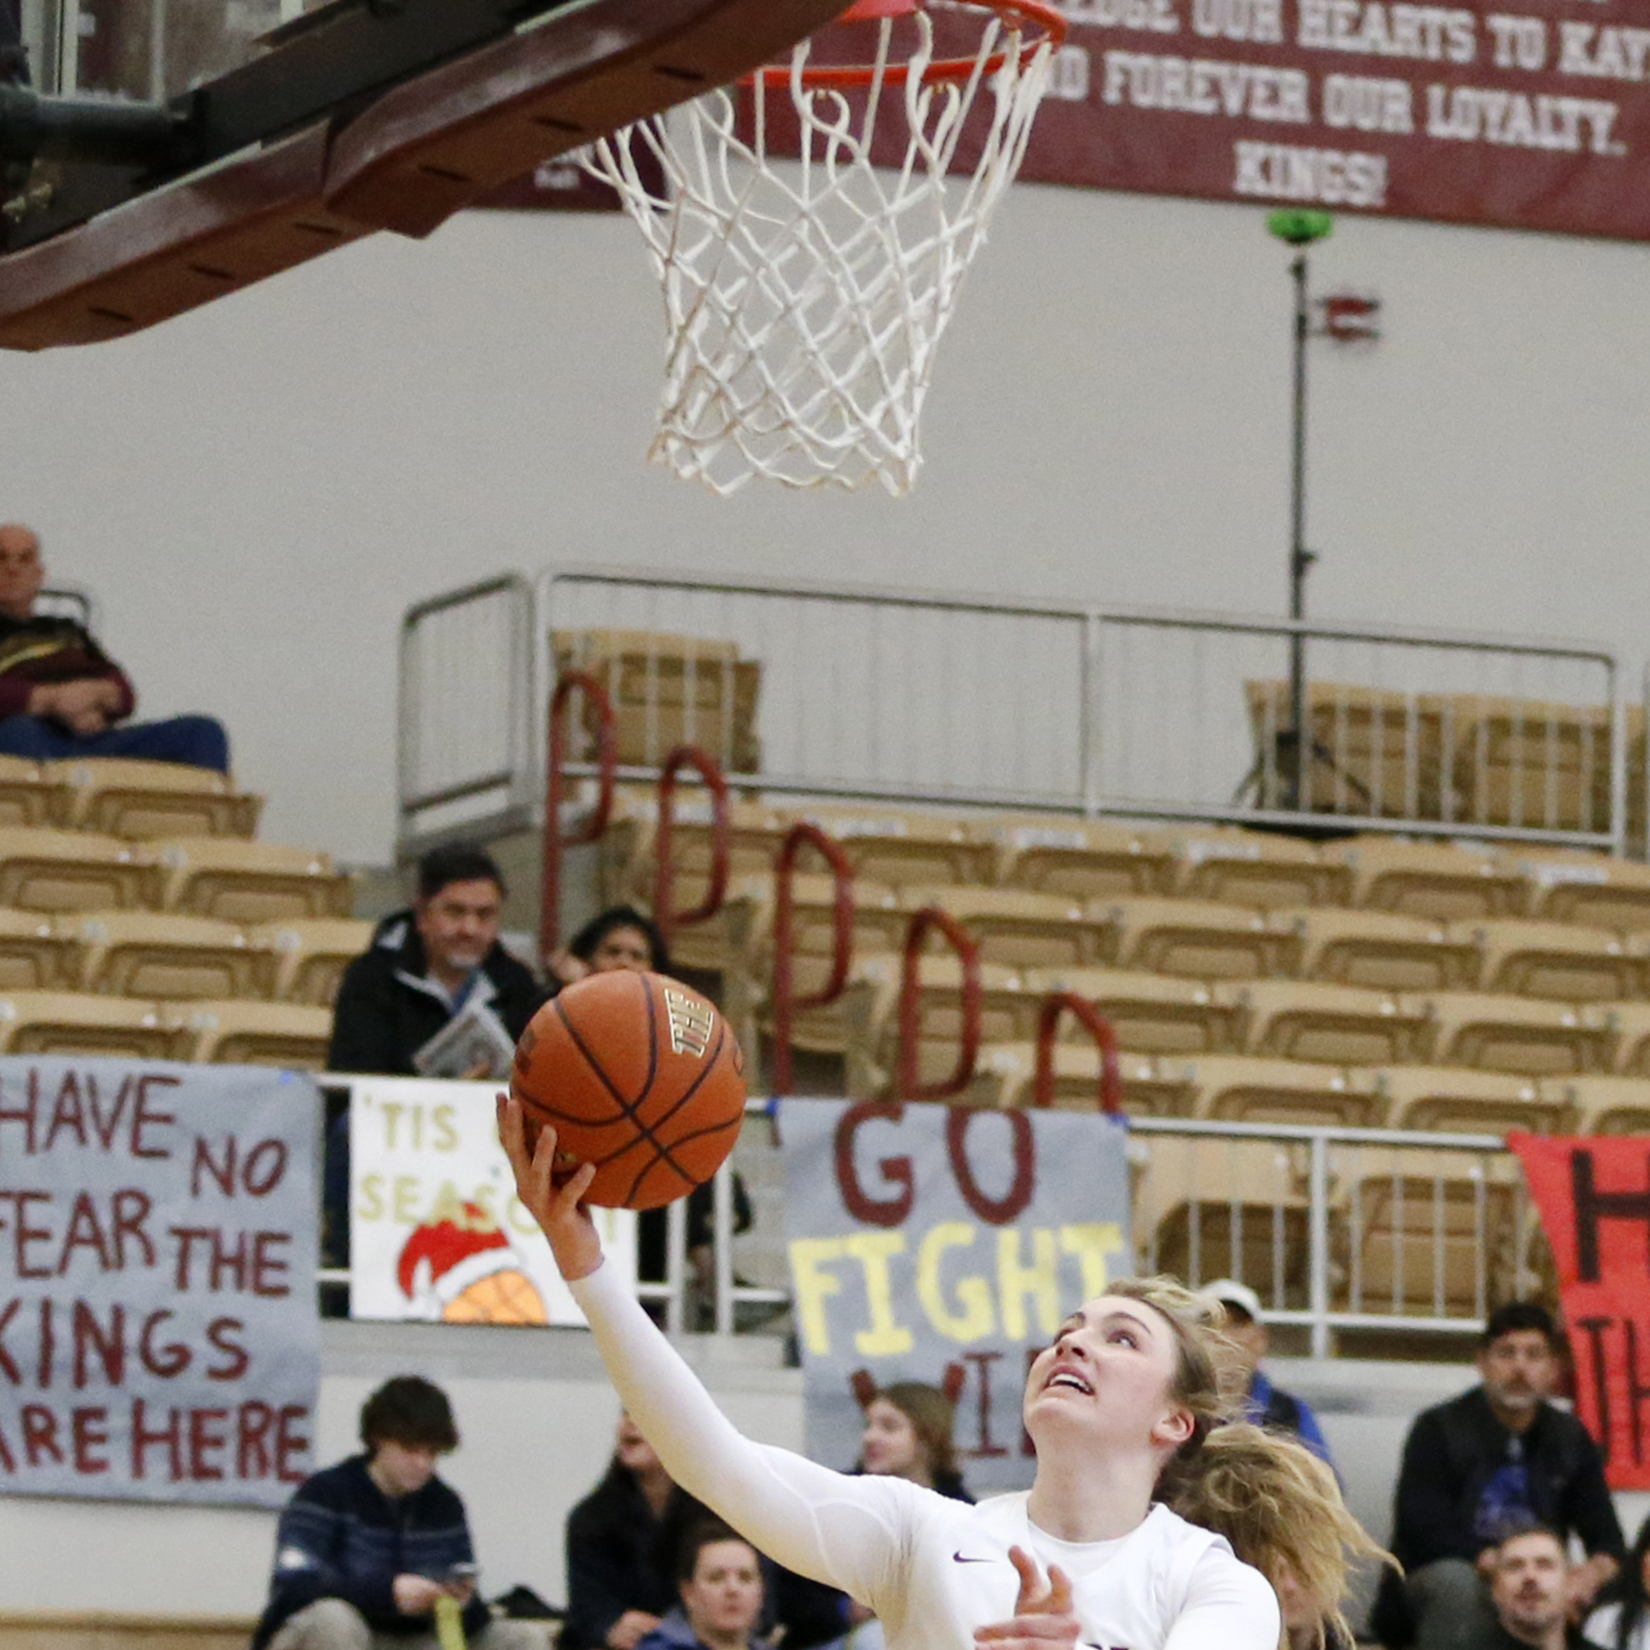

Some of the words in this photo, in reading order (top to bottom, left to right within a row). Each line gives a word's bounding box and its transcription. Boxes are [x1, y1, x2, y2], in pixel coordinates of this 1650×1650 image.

[1296, 0, 1477, 64] HEARTS
[1486, 13, 1548, 70] TO
[1101, 50, 1309, 120] FOREVER
[1322, 73, 1414, 134] OUR
[1426, 83, 1629, 156] LOYALTY.
[1234, 141, 1388, 208] KINGS!
[0, 1066, 181, 1159] HAVE
[190, 1133, 289, 1198] NO
[834, 1100, 1036, 1227] GO
[0, 1188, 156, 1280] EAR
[168, 1224, 292, 1296] THE
[788, 1221, 1125, 1358] FIGHT
[0, 1296, 250, 1390] KINGS
[131, 1397, 309, 1483] HERE
